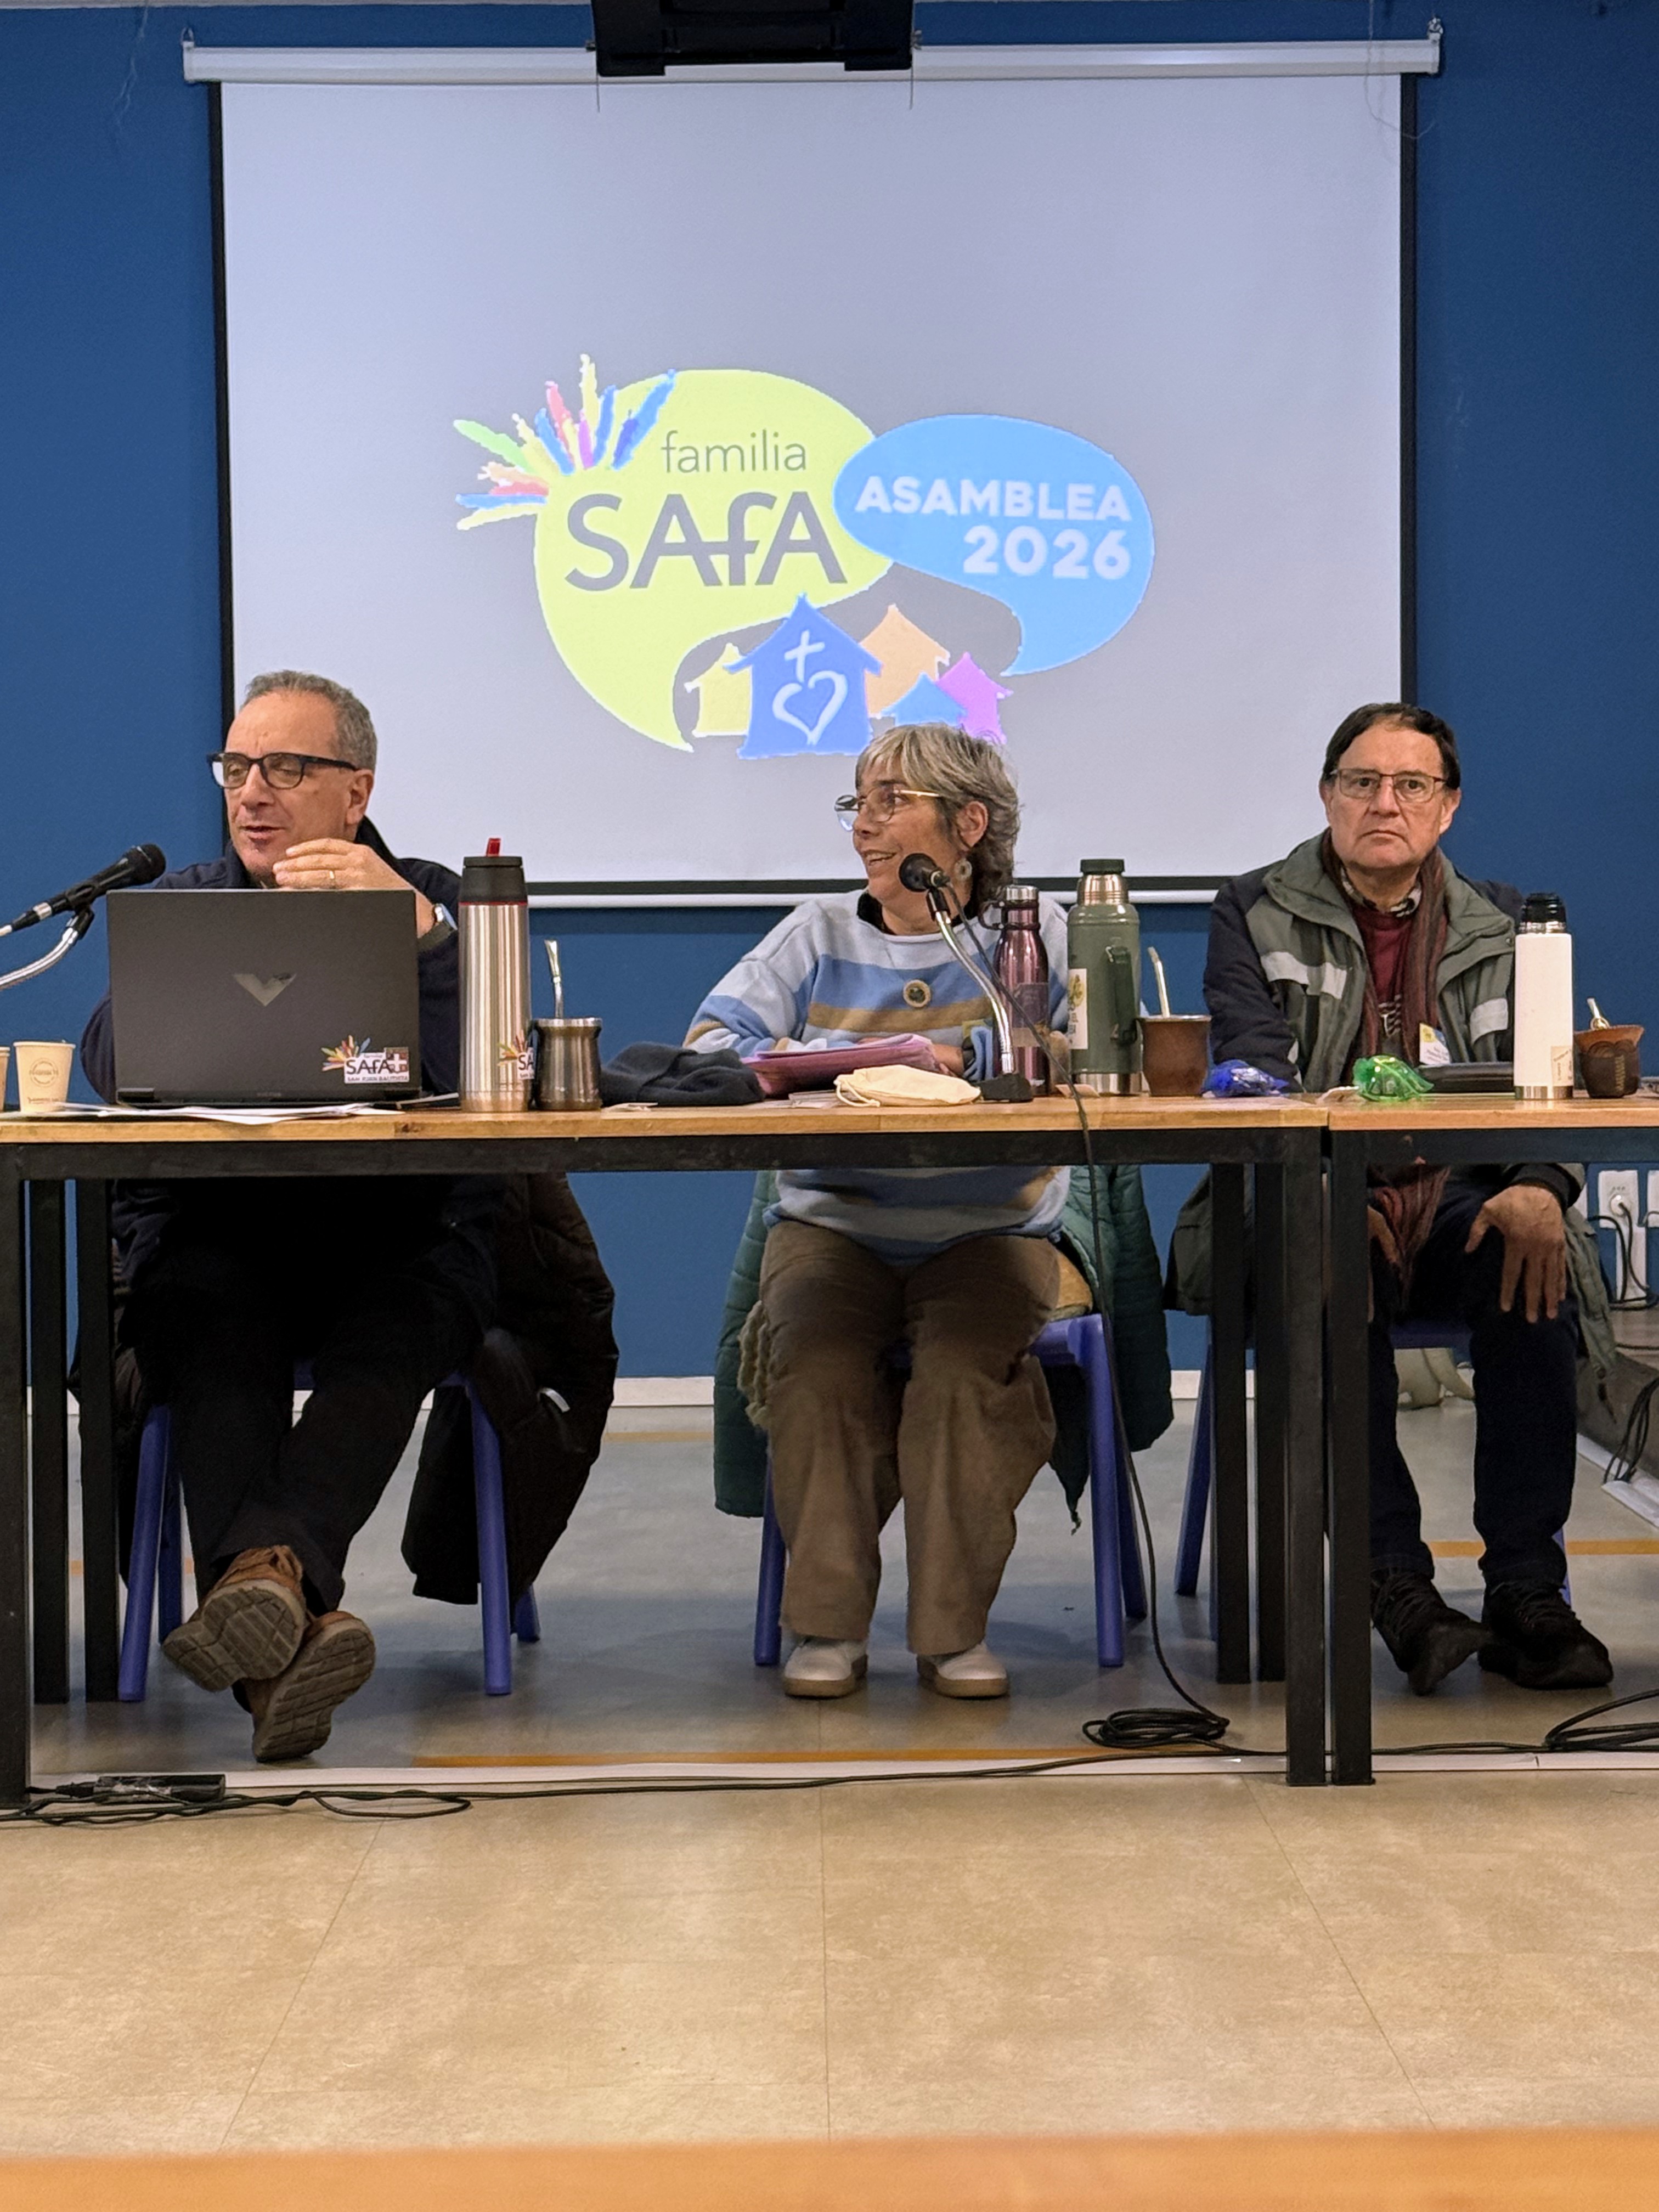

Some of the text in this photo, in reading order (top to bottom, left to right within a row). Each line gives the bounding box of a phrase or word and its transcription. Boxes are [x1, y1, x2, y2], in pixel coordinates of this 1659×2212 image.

[661, 429, 806, 473] familia
[854, 476, 1132, 521] ASAMBLEA
[565, 492, 848, 591] SAfA
[963, 524, 1132, 580] 2026
